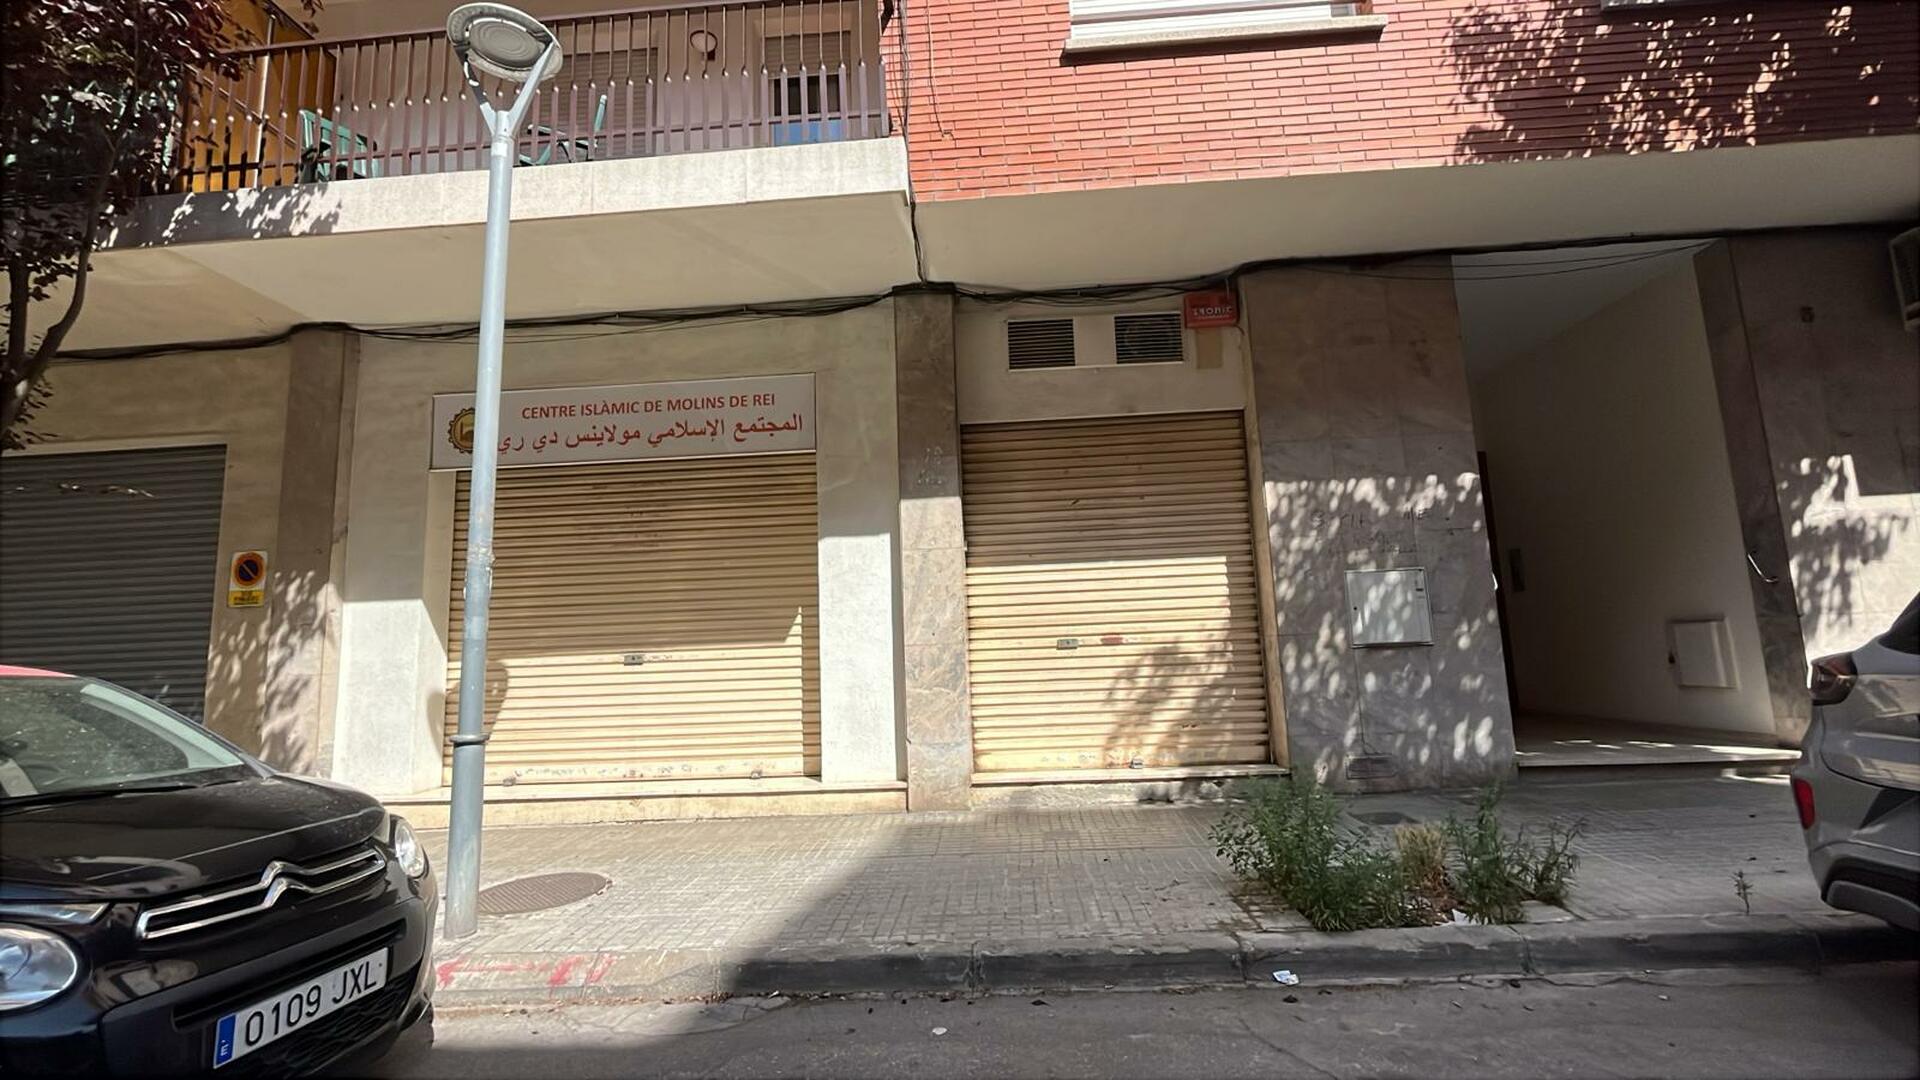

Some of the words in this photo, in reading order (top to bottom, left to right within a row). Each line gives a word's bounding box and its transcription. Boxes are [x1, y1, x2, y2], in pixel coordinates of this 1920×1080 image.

[521, 404, 576, 420] CENTRE
[580, 398, 640, 417] ISLÀMIC
[643, 399, 663, 413] DE
[666, 396, 726, 412] MOLINS
[729, 394, 748, 408] DE
[752, 392, 775, 407] REI
[531, 431, 559, 454] دي
[646, 418, 725, 448] الإسلامي
[733, 412, 803, 443] المجتمع
[245, 984, 321, 1047] 0109
[331, 961, 377, 1004] JXL
